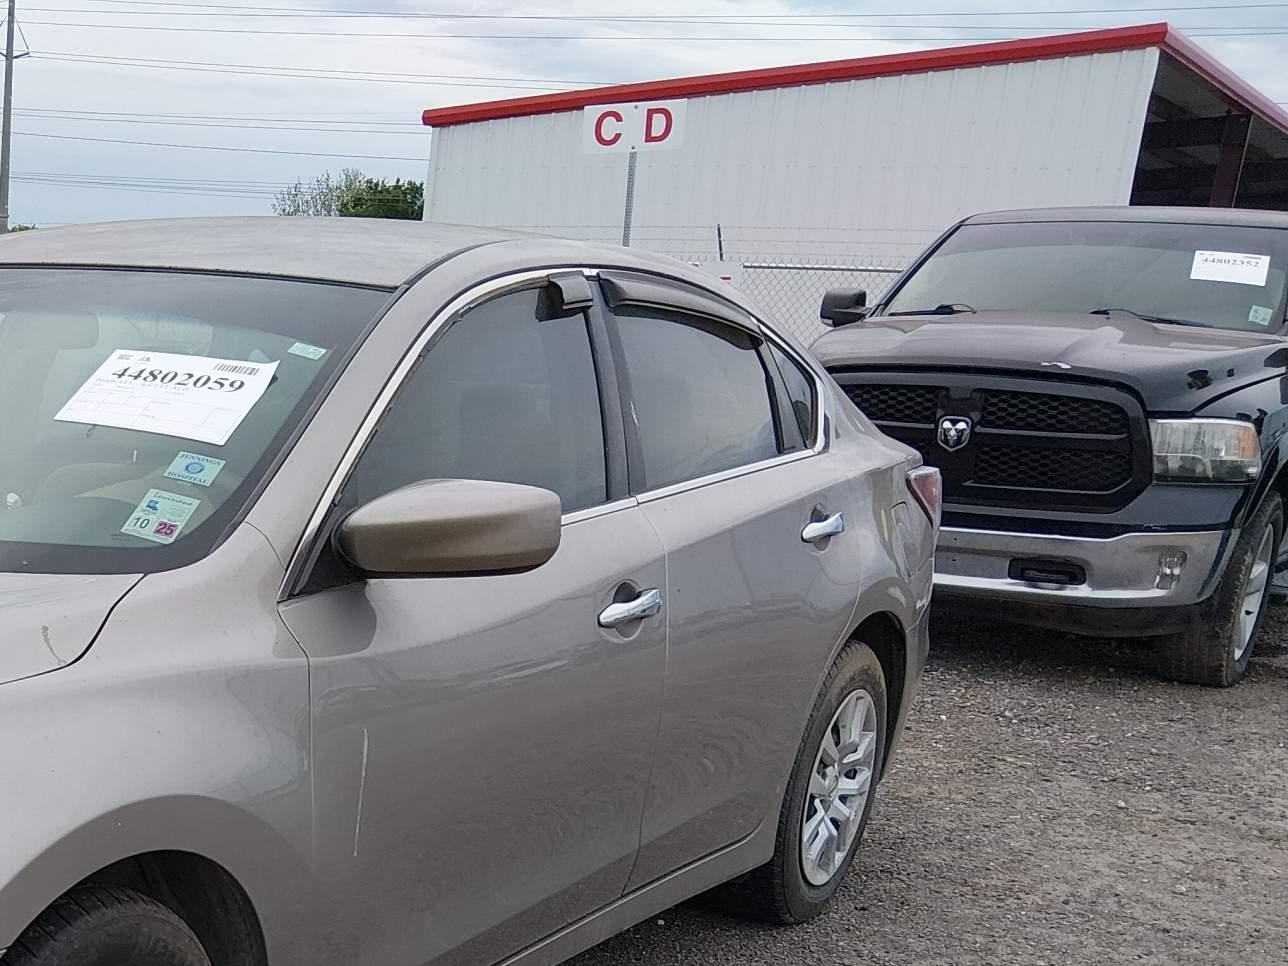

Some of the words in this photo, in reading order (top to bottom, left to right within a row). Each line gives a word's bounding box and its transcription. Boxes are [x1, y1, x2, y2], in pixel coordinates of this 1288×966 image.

[595, 111, 623, 146] C
[644, 108, 673, 143] D
[112, 366, 245, 393] 44802059
[180, 453, 222, 466] JENNINGS
[167, 471, 208, 484] HOSPITAL
[132, 516, 150, 529] 10
[155, 522, 176, 536] 25
